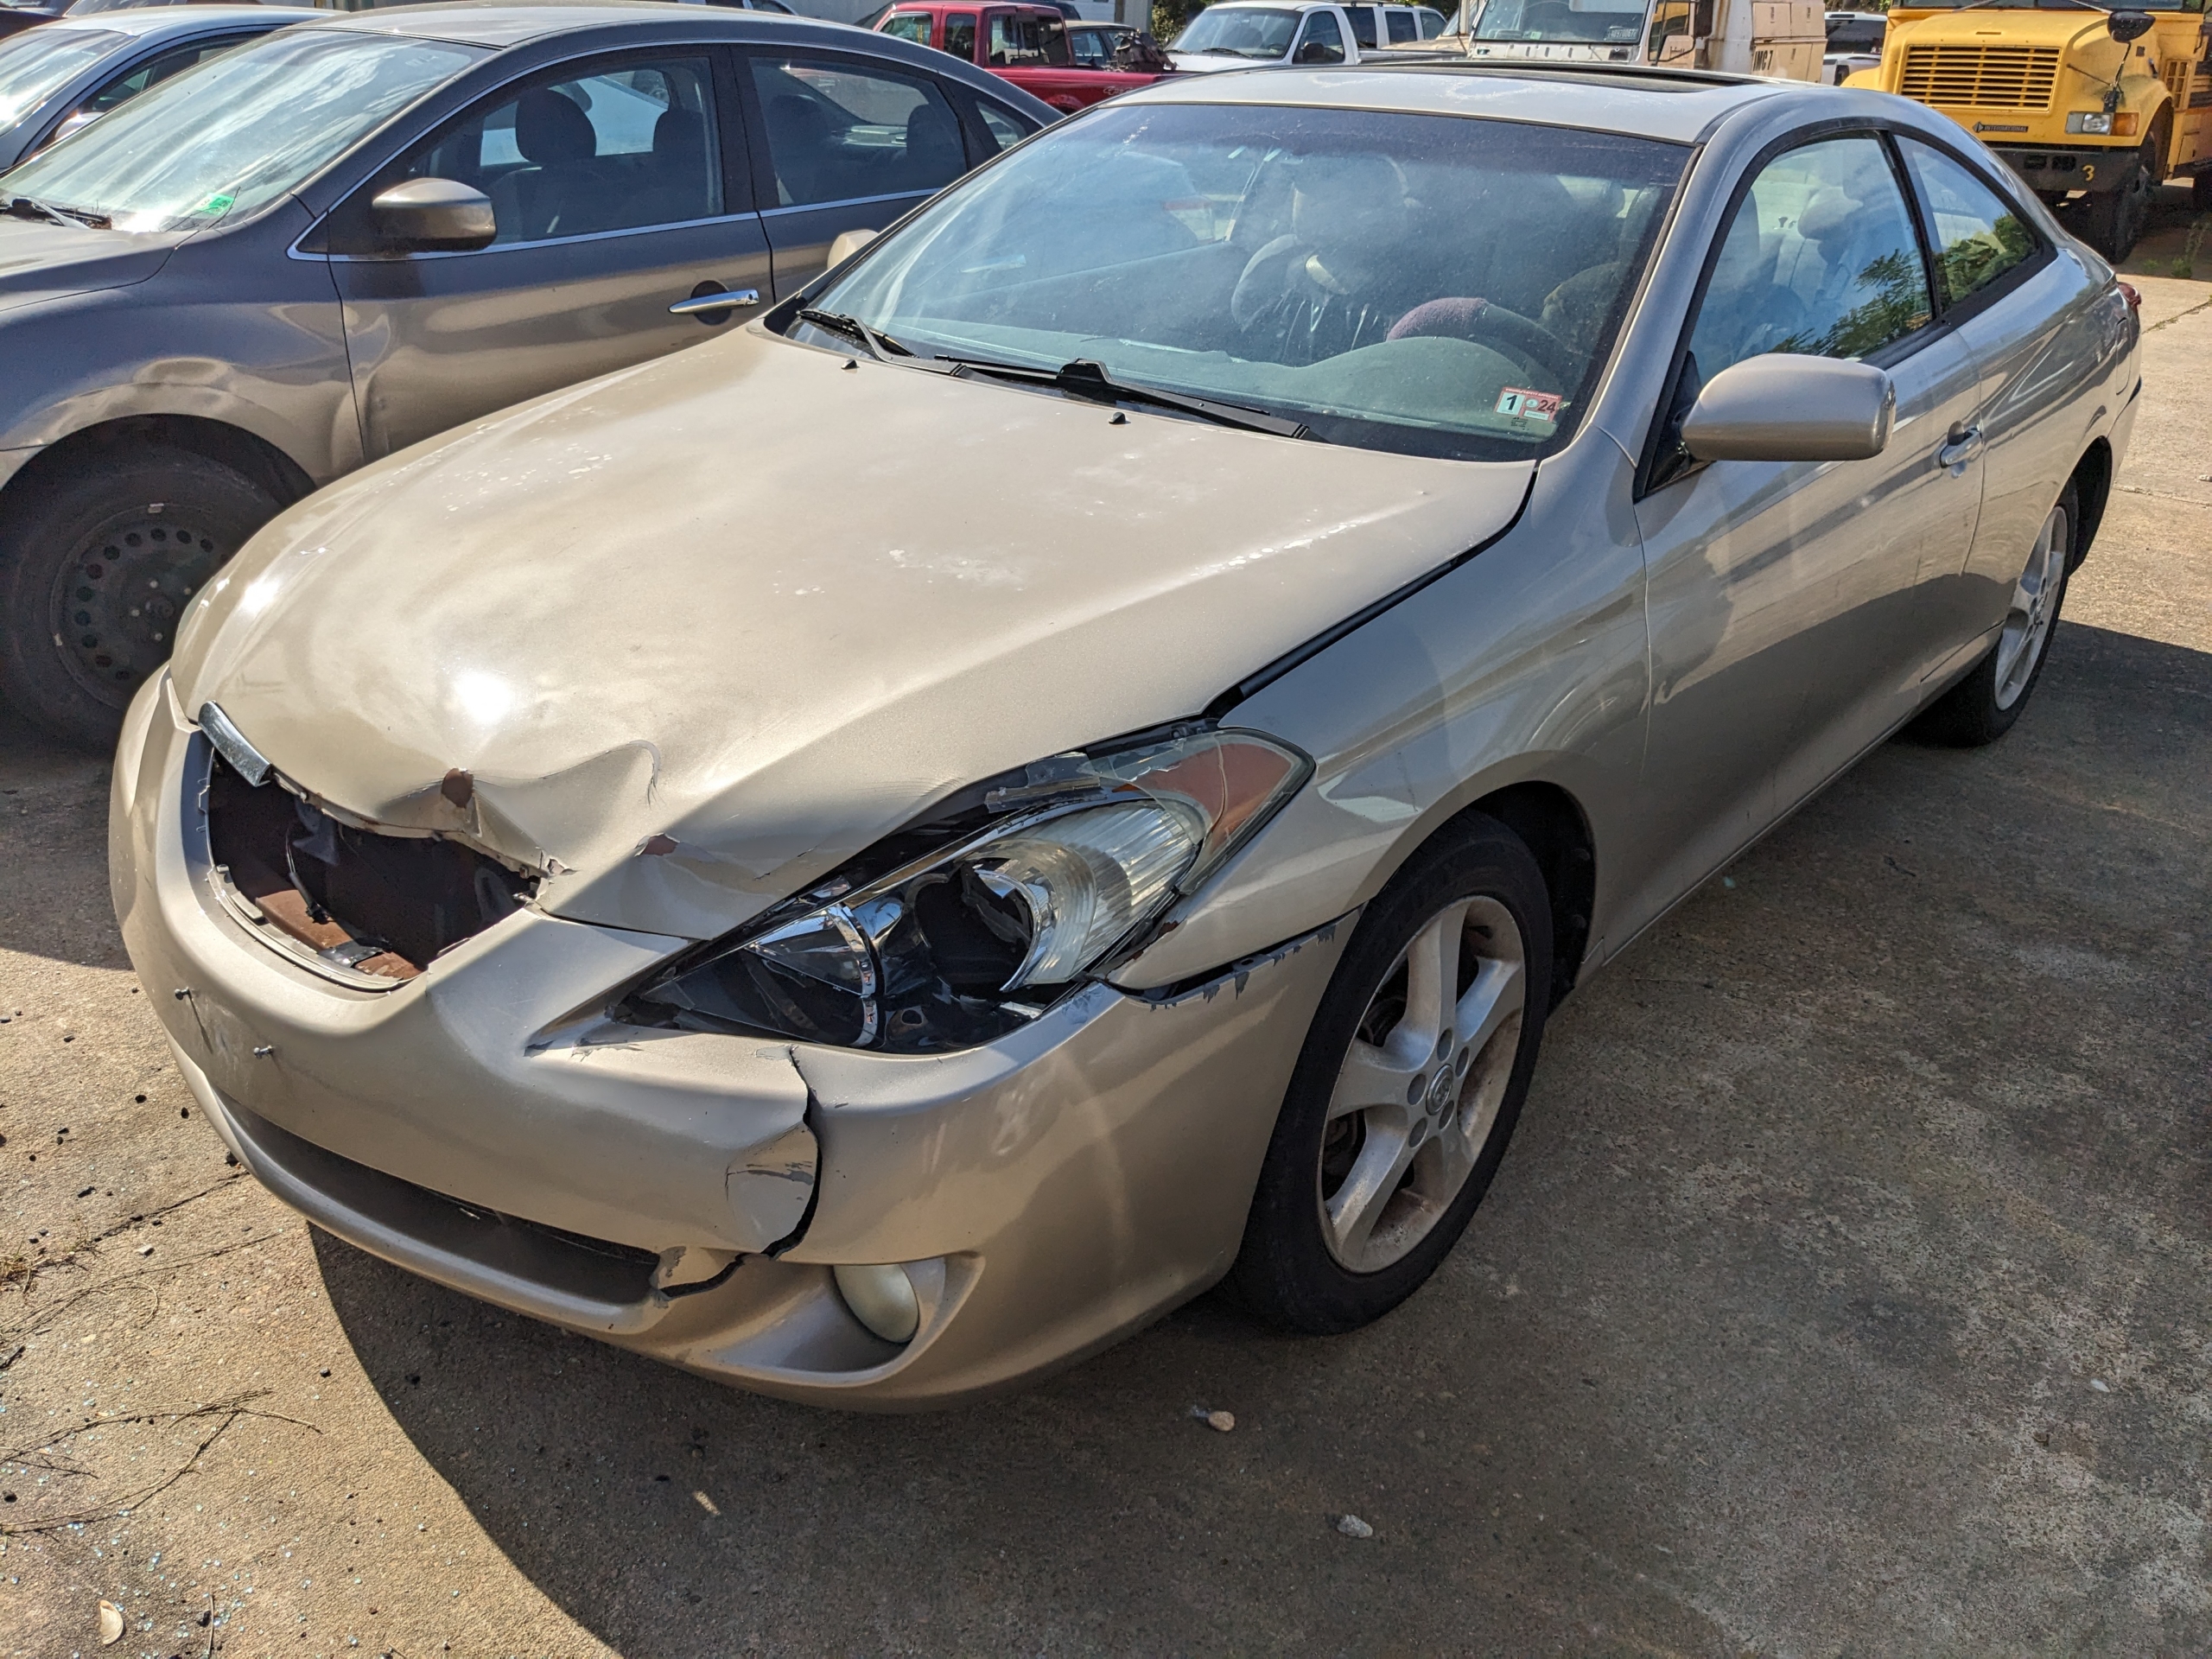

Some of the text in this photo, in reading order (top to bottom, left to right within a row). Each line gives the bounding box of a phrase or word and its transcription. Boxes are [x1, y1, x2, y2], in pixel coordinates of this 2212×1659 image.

[2082, 164, 2094, 181] 3
[1507, 395, 1557, 414] 1 24
